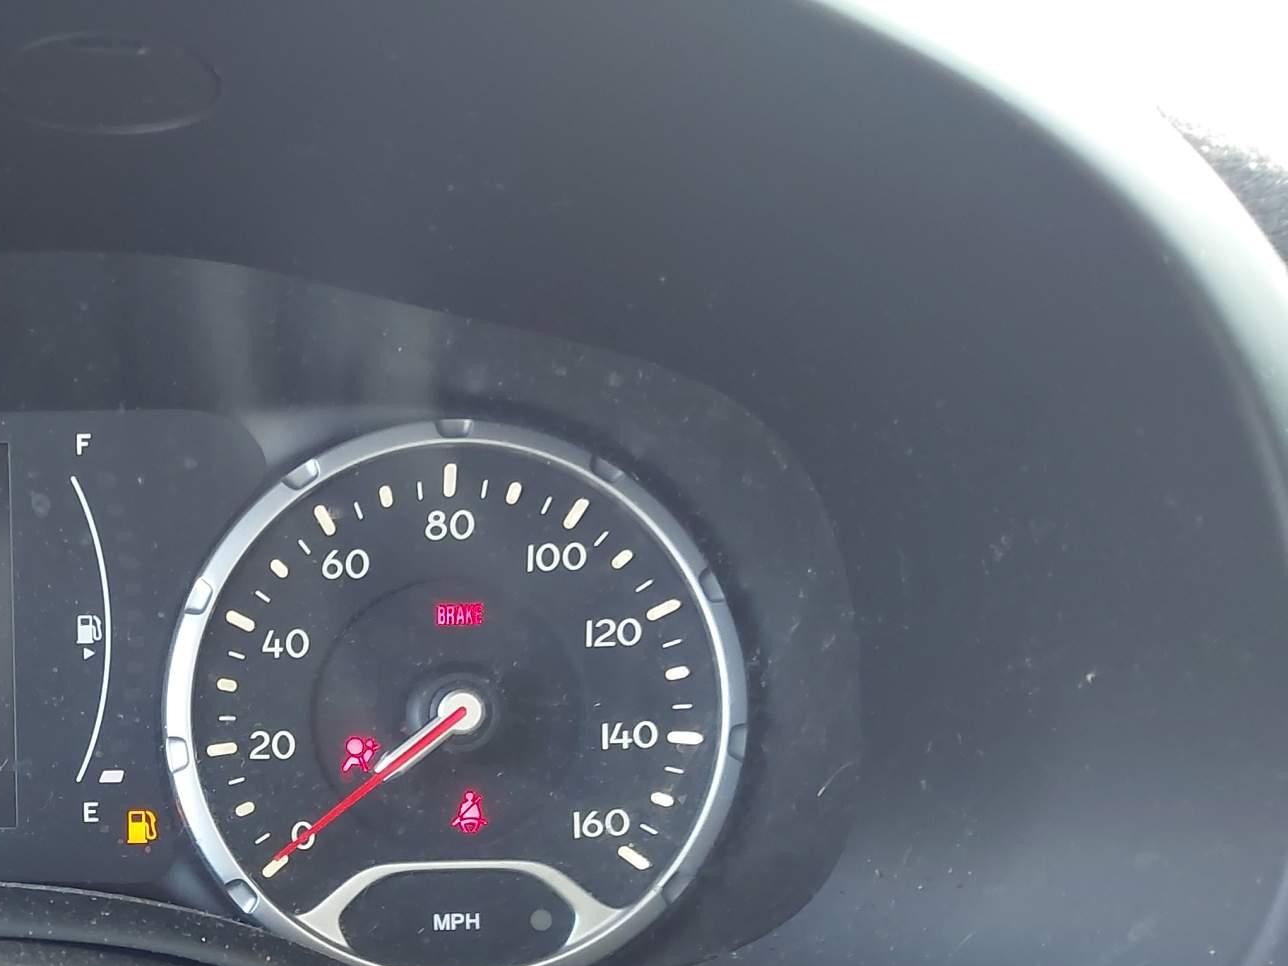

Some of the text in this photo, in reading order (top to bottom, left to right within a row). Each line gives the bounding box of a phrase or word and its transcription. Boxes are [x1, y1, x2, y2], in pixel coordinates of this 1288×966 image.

[77, 434, 91, 455] F
[426, 510, 474, 540] 80
[322, 549, 369, 579] 60
[528, 543, 586, 572] 100
[436, 606, 482, 624] BRAKE
[263, 629, 309, 658] 40
[586, 618, 641, 647] 120
[250, 731, 295, 759] 20
[602, 721, 658, 749] 140
[84, 802, 99, 822] E
[574, 809, 630, 838] 160
[291, 821, 316, 849] 0
[434, 913, 479, 930] MPH
